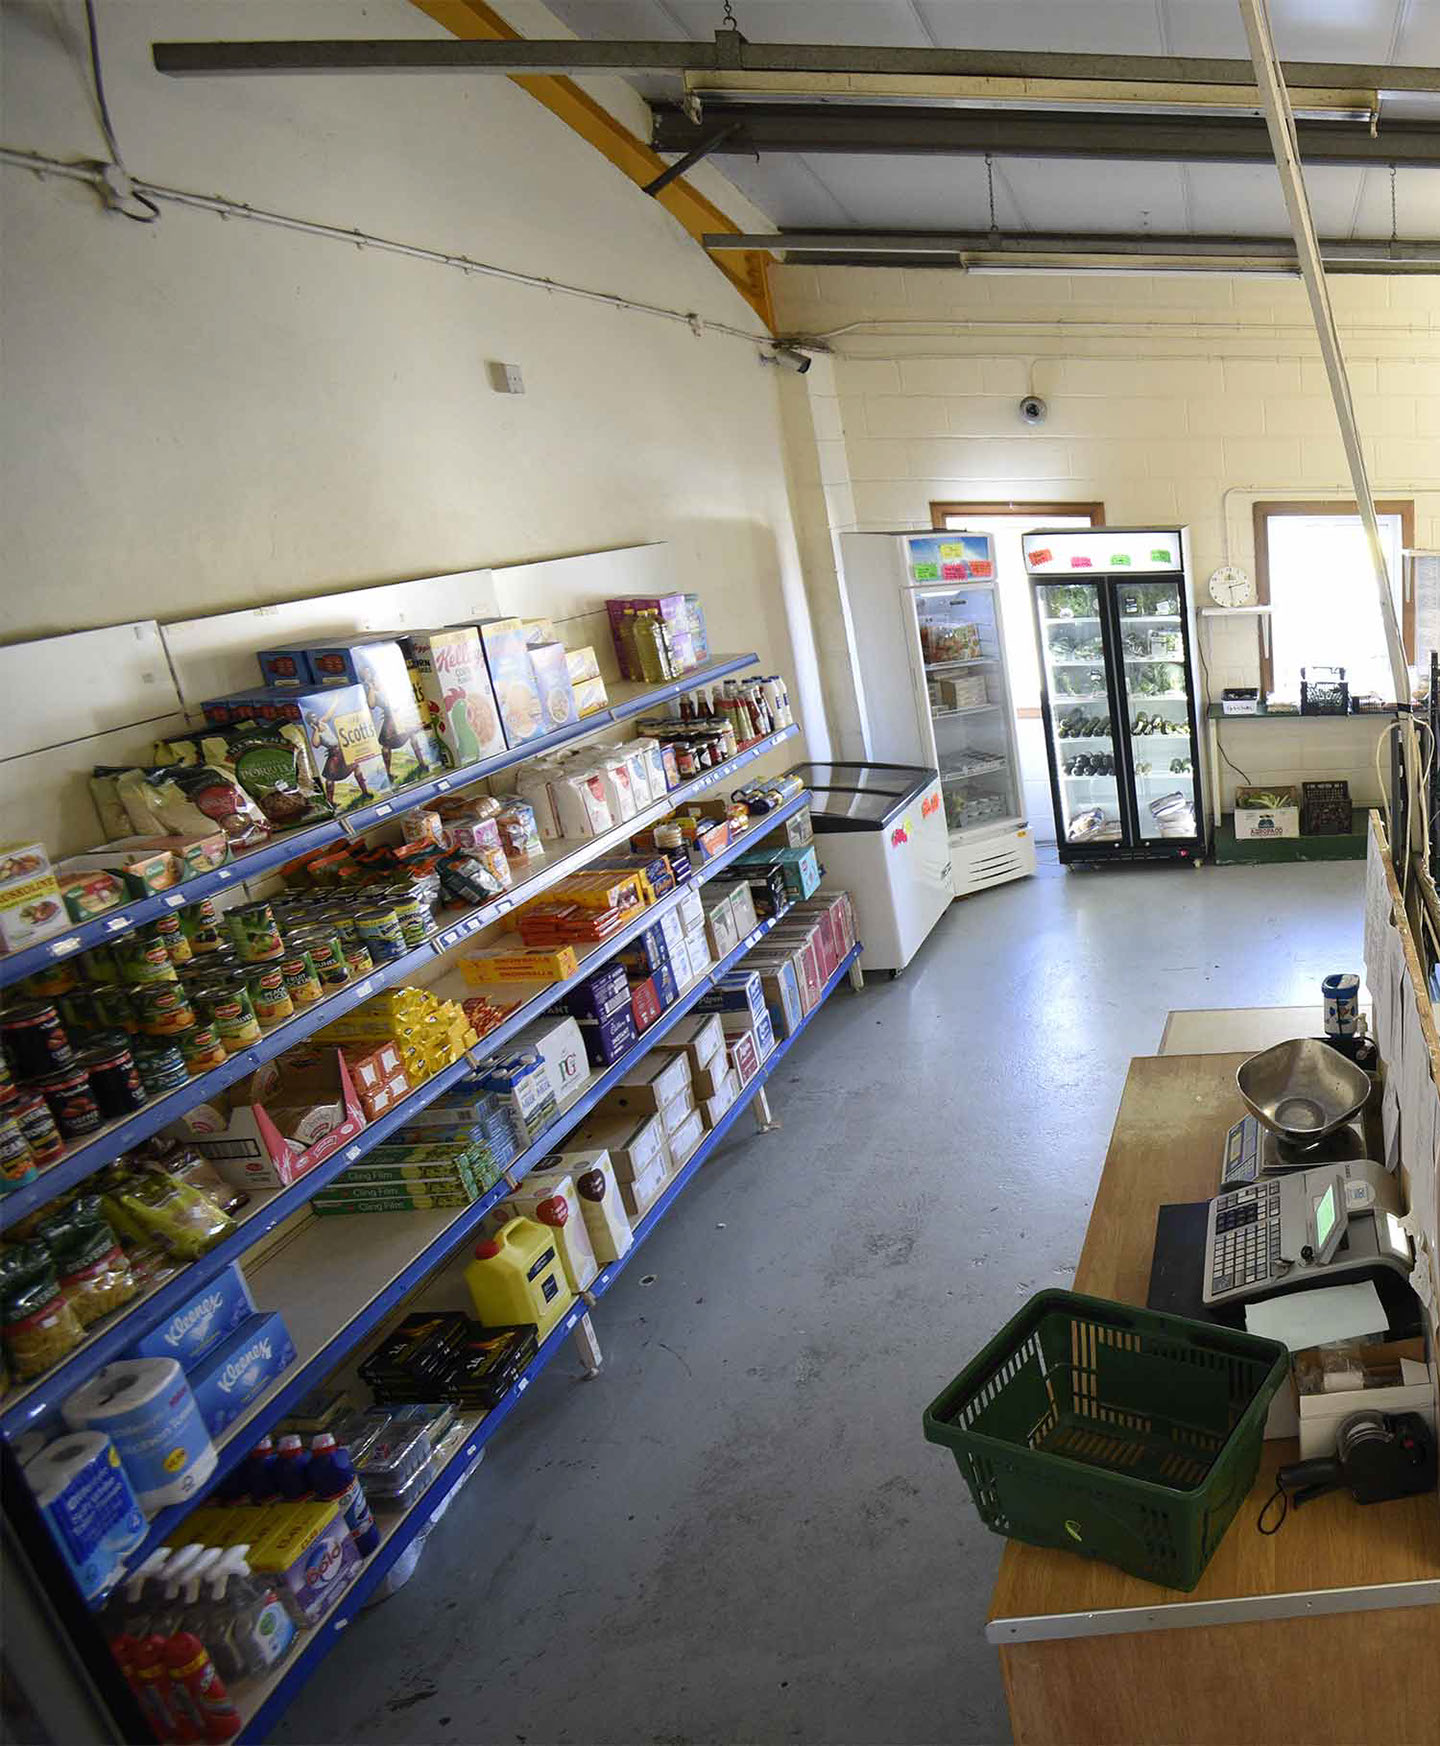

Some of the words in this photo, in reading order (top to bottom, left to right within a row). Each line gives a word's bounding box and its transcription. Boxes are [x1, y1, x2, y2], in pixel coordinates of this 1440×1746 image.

[559, 1054, 577, 1082] PG
[164, 1292, 223, 1345] Kleenex
[217, 1336, 273, 1393] Kleenex
